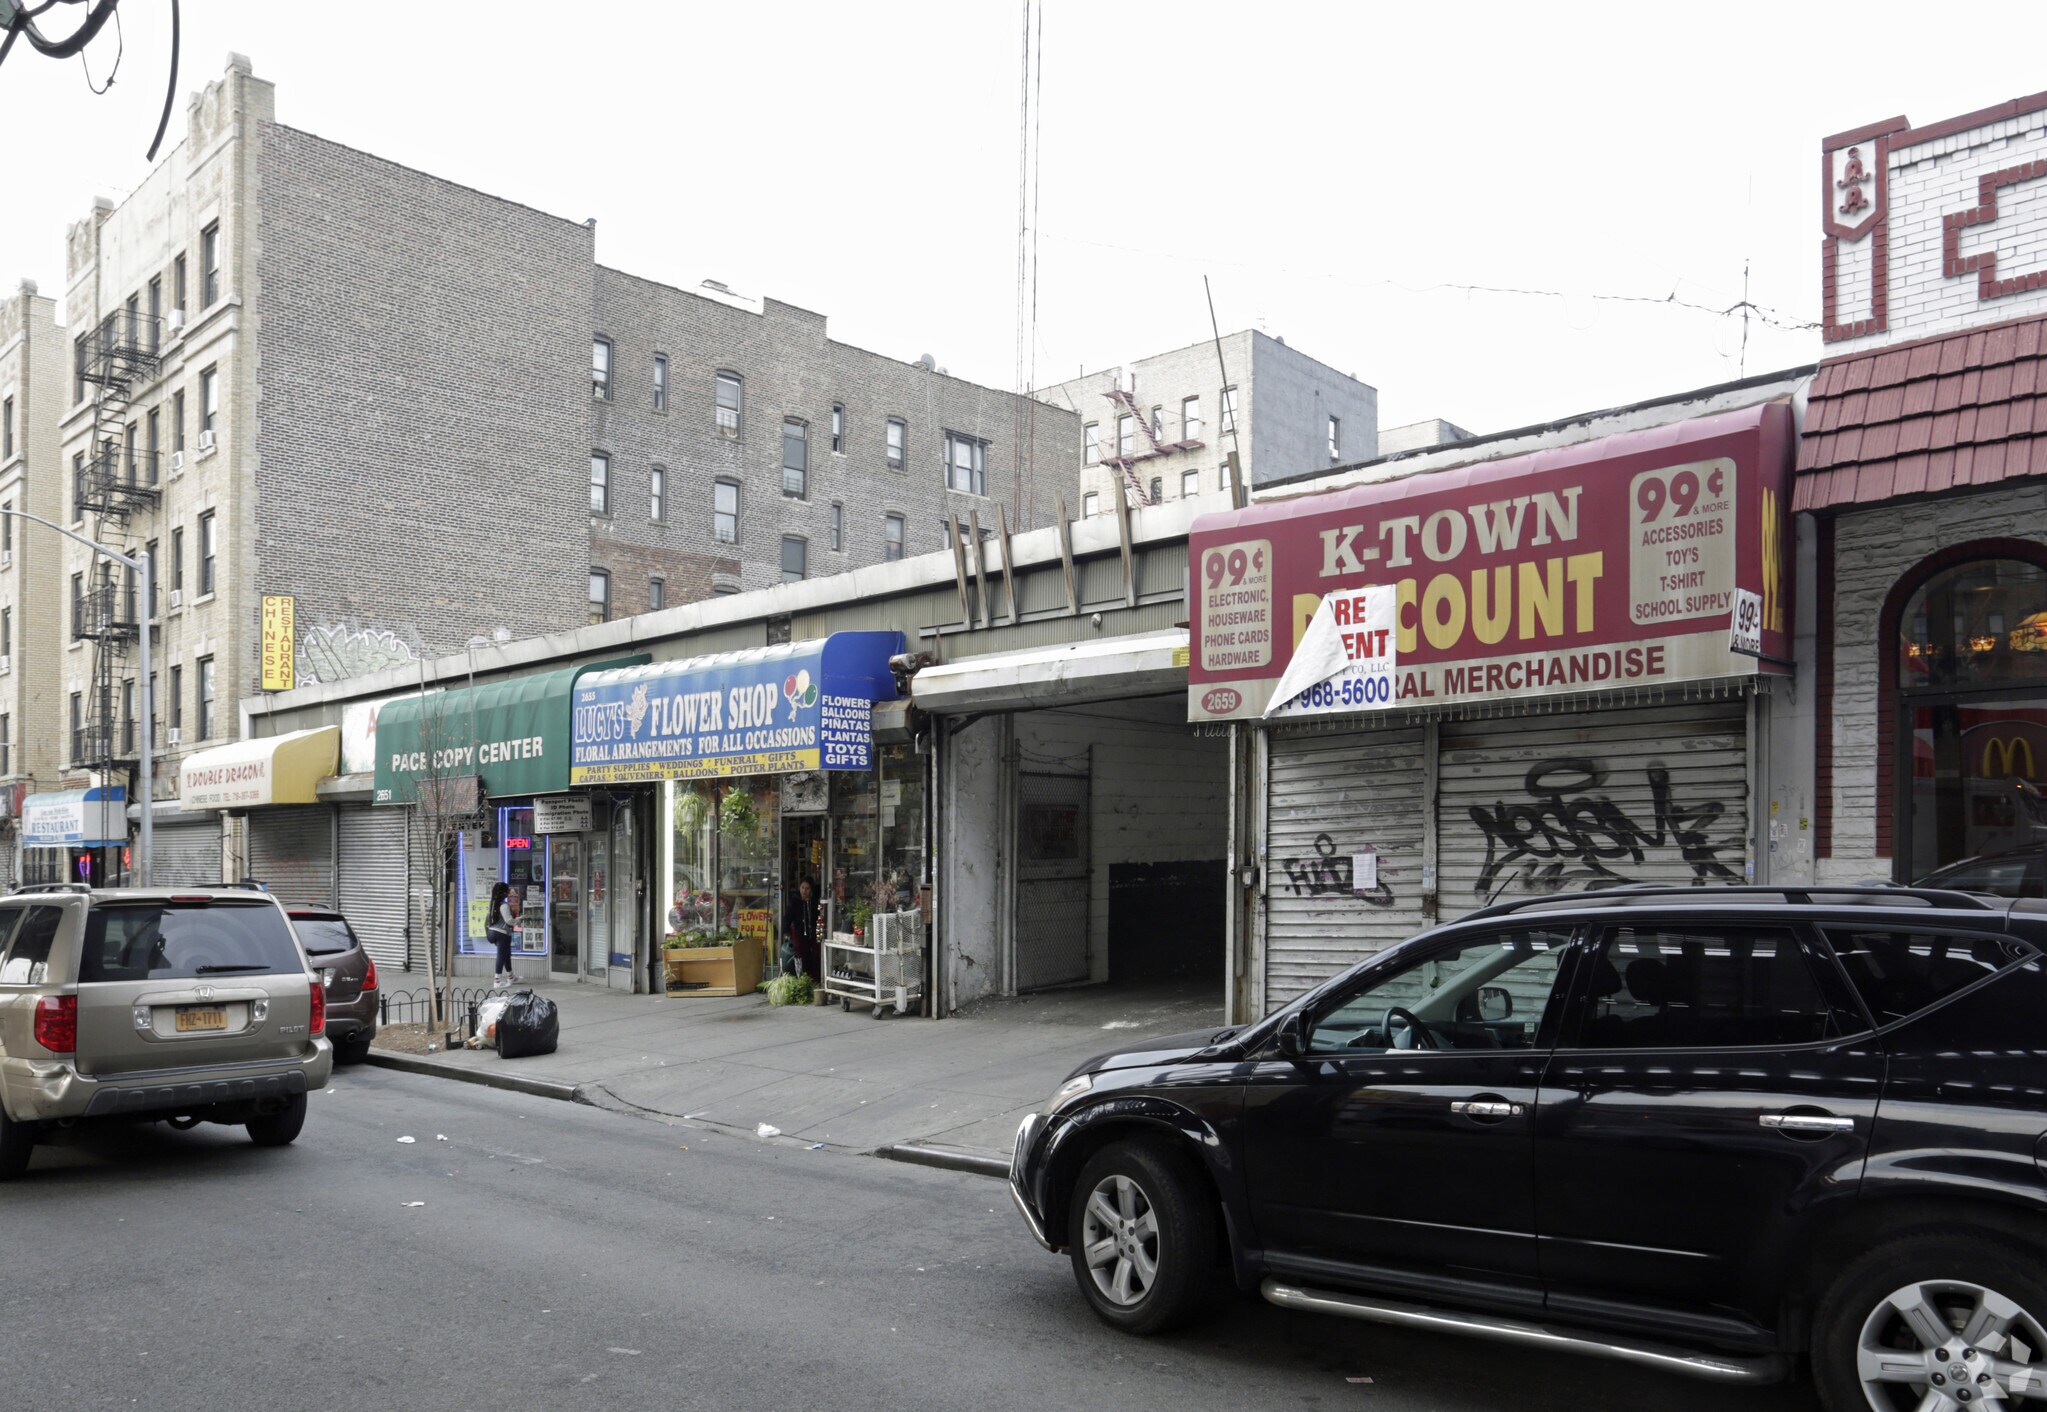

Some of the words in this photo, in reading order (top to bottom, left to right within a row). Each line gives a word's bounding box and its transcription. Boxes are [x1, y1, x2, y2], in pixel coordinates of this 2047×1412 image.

[1693, 507, 1699, 515] &
[1702, 501, 1729, 514] MORE
[1319, 485, 1583, 578] K-TOWN
[1642, 518, 1723, 546] ACCESSORIES
[1666, 547, 1699, 566] TOY'S
[1249, 575, 1267, 584] MORE
[1660, 570, 1705, 591] T-SHIRT
[1209, 589, 1269, 608] ELECTRONIC,
[1293, 551, 1603, 656] DCOUNT
[1636, 599, 1682, 619] SCHOOL
[1687, 592, 1731, 612] SUPPLY
[1208, 609, 1266, 627] HOUSEWARE
[265, 597, 276, 679] CHINESE
[280, 598, 291, 688] RESTAURANT
[1205, 632, 1236, 648] PHONE
[1238, 629, 1269, 645] CARDS
[1208, 650, 1260, 666] HARDWARE
[1371, 662, 1389, 672] LLC
[1396, 672, 1435, 699] AL
[1444, 645, 1665, 695] MERCHANDISE
[581, 692, 596, 702] 2655
[822, 695, 871, 709] FLOWERS
[1207, 692, 1236, 710] 2659
[575, 701, 624, 743] LUCY'S
[650, 690, 722, 736] FLOWER
[728, 683, 778, 730] SHOP
[822, 707, 871, 720] BALLOONS
[821, 718, 870, 731] PIÑATAS
[575, 743, 611, 762] FLORAL
[612, 737, 692, 760] ARRANGEMENTS
[698, 735, 720, 754] FOR
[722, 731, 743, 752] ALL
[745, 726, 816, 750] OCCASSIONS
[821, 730, 870, 743] PLANTAS
[392, 752, 426, 772] PACE
[433, 746, 474, 769] COPY
[479, 736, 543, 764] CENTER
[825, 743, 867, 755] TOYS
[587, 765, 611, 774] PARTY
[613, 763, 650, 773] SUPPLIES
[659, 759, 703, 770] WEDDINGS
[714, 755, 758, 766] FUNERAL
[768, 752, 796, 762] GIFTS
[825, 754, 868, 766] GIFTS
[193, 769, 223, 787] DOUBLE
[226, 763, 258, 784] DRAGON
[614, 771, 664, 782] SOUVENIERS
[673, 768, 718, 778] BALLOONS
[731, 764, 766, 775] POTTER
[768, 761, 804, 772] PLANTS
[376, 789, 392, 801] 2651
[31, 820, 79, 833] RESTAURANT
[506, 838, 529, 848] OPEN
[738, 911, 773, 922] FLOWERS
[280, 1025, 305, 1033] PILOT
